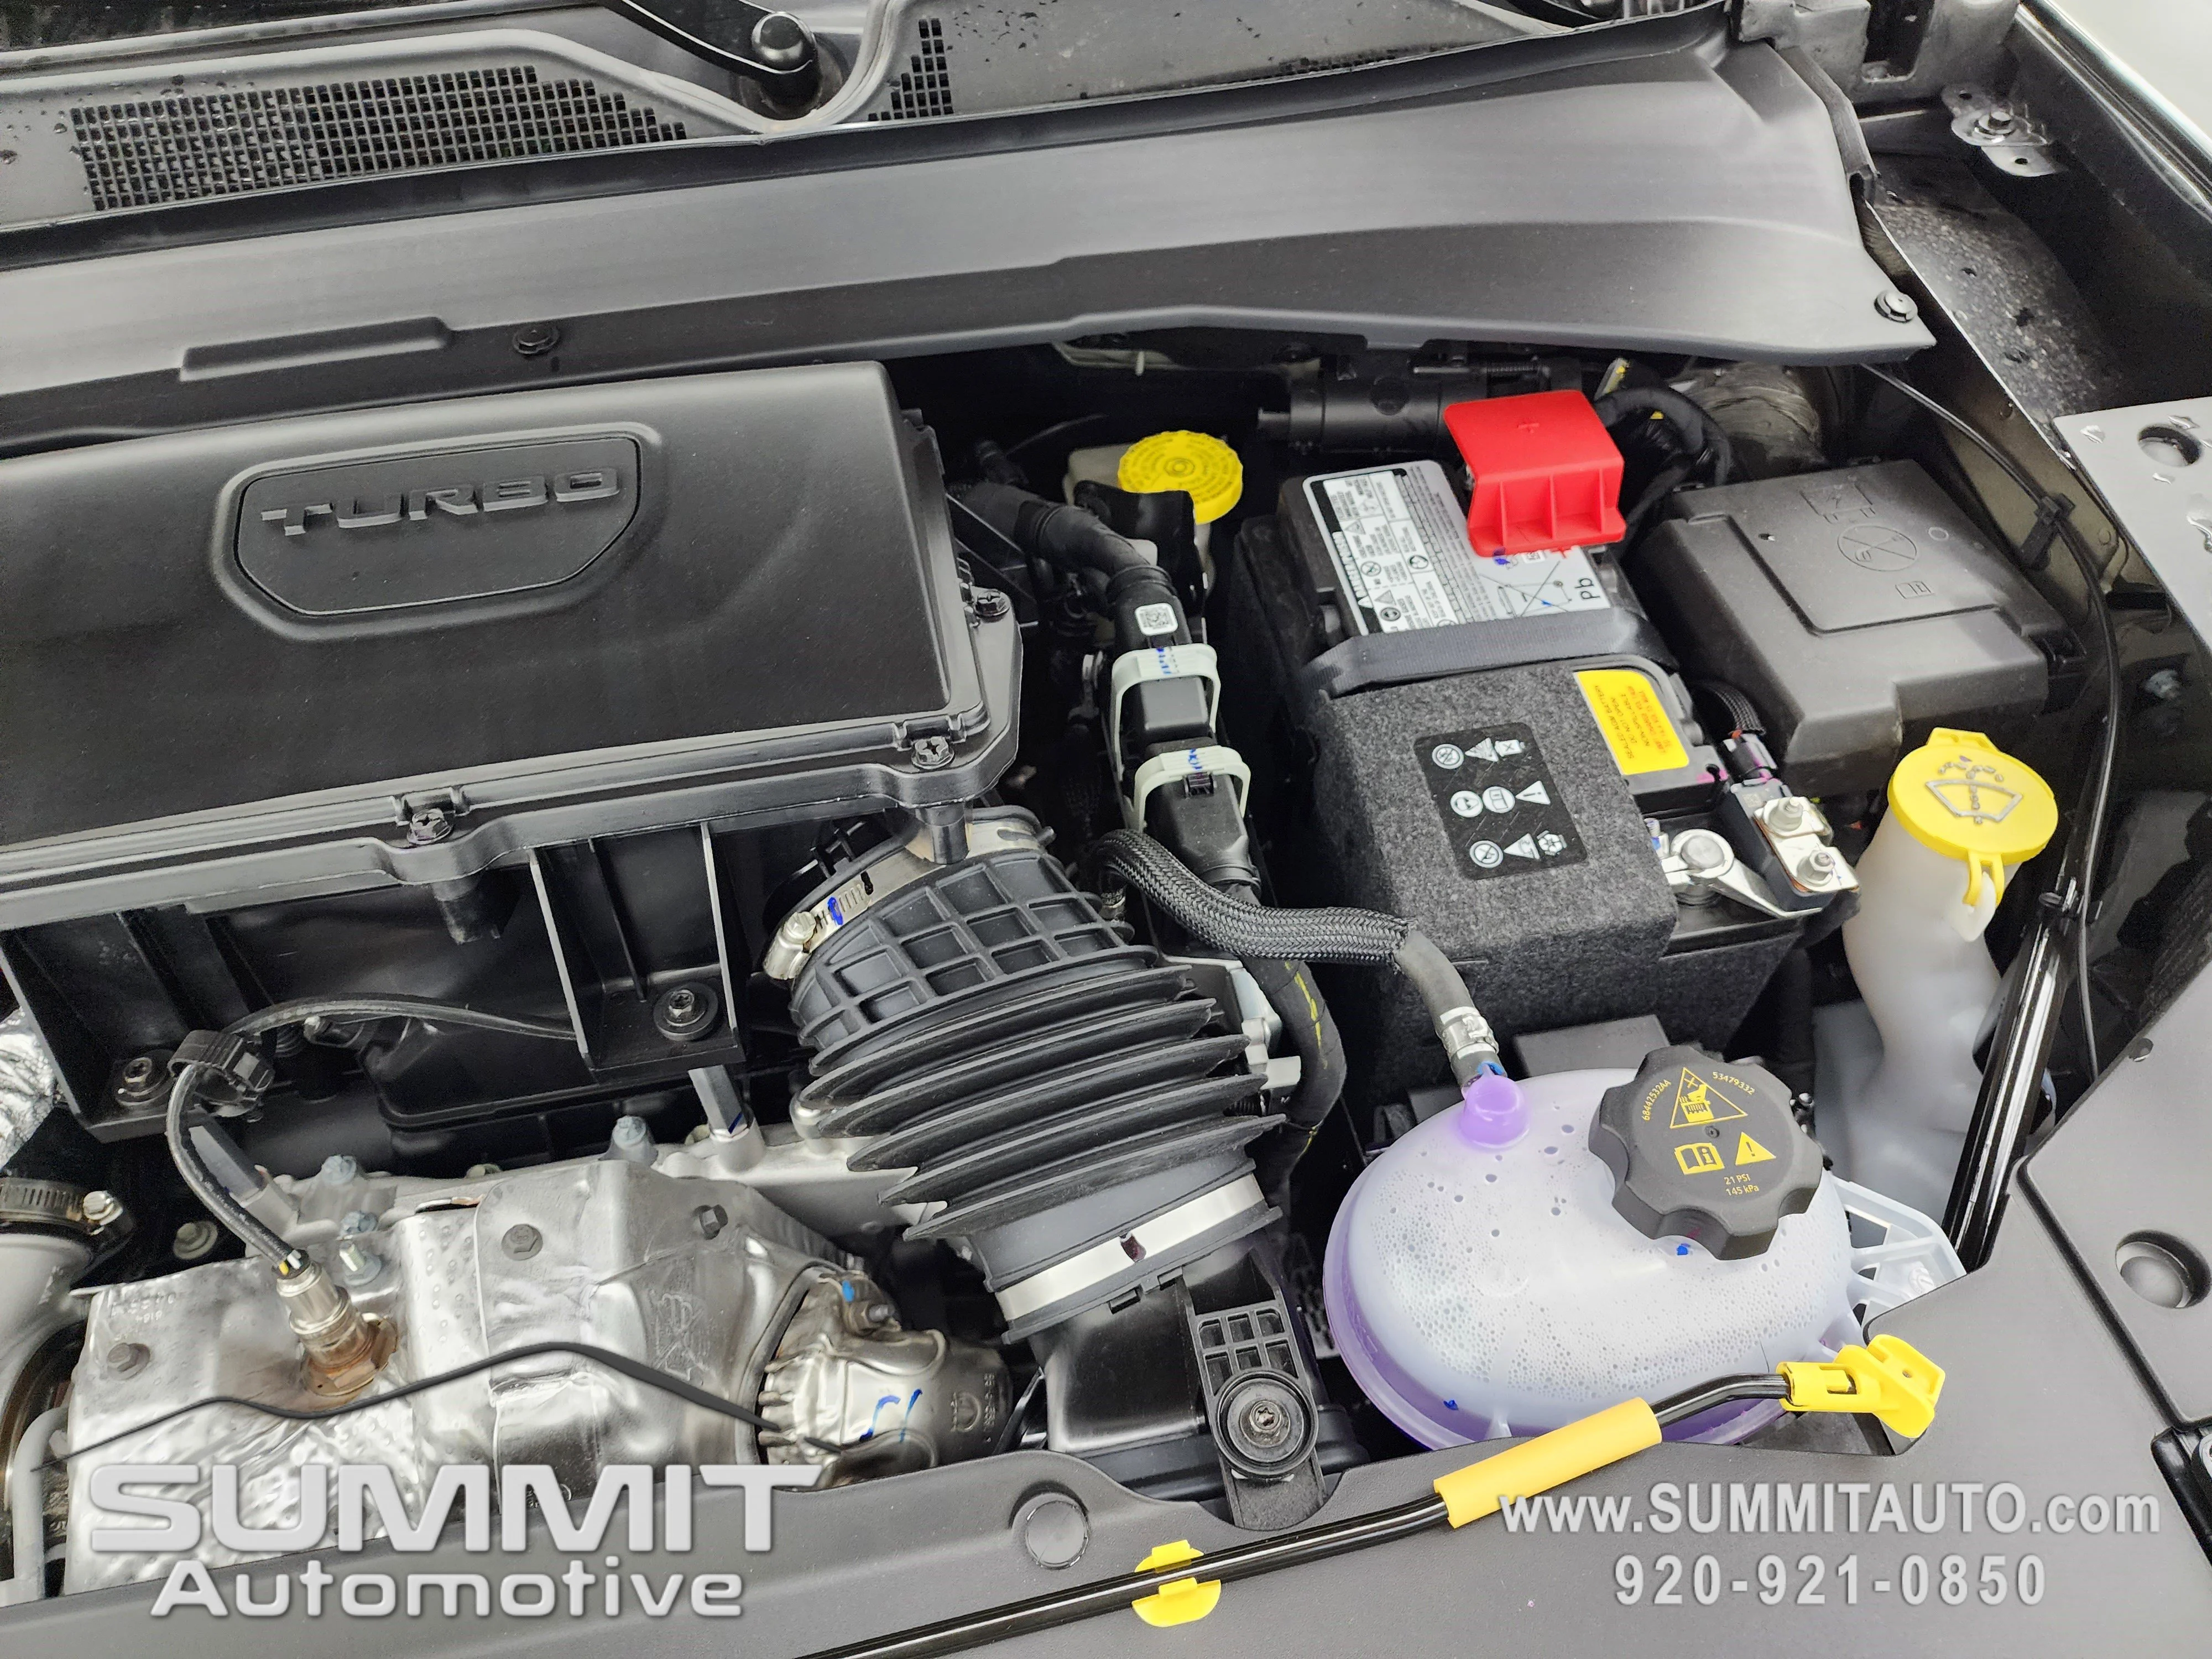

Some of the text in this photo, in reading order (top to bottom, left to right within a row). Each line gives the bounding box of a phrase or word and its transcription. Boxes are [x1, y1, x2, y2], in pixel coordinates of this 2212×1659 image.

[260, 468, 619, 536] TURBO
[1575, 577, 1600, 601] Pb
[1712, 1071, 1756, 1095] 53479332
[1642, 1079, 1672, 1121] 68442532AA
[1724, 1173, 1751, 1185] 21 PSI
[1726, 1185, 1759, 1196] 145 kPa
